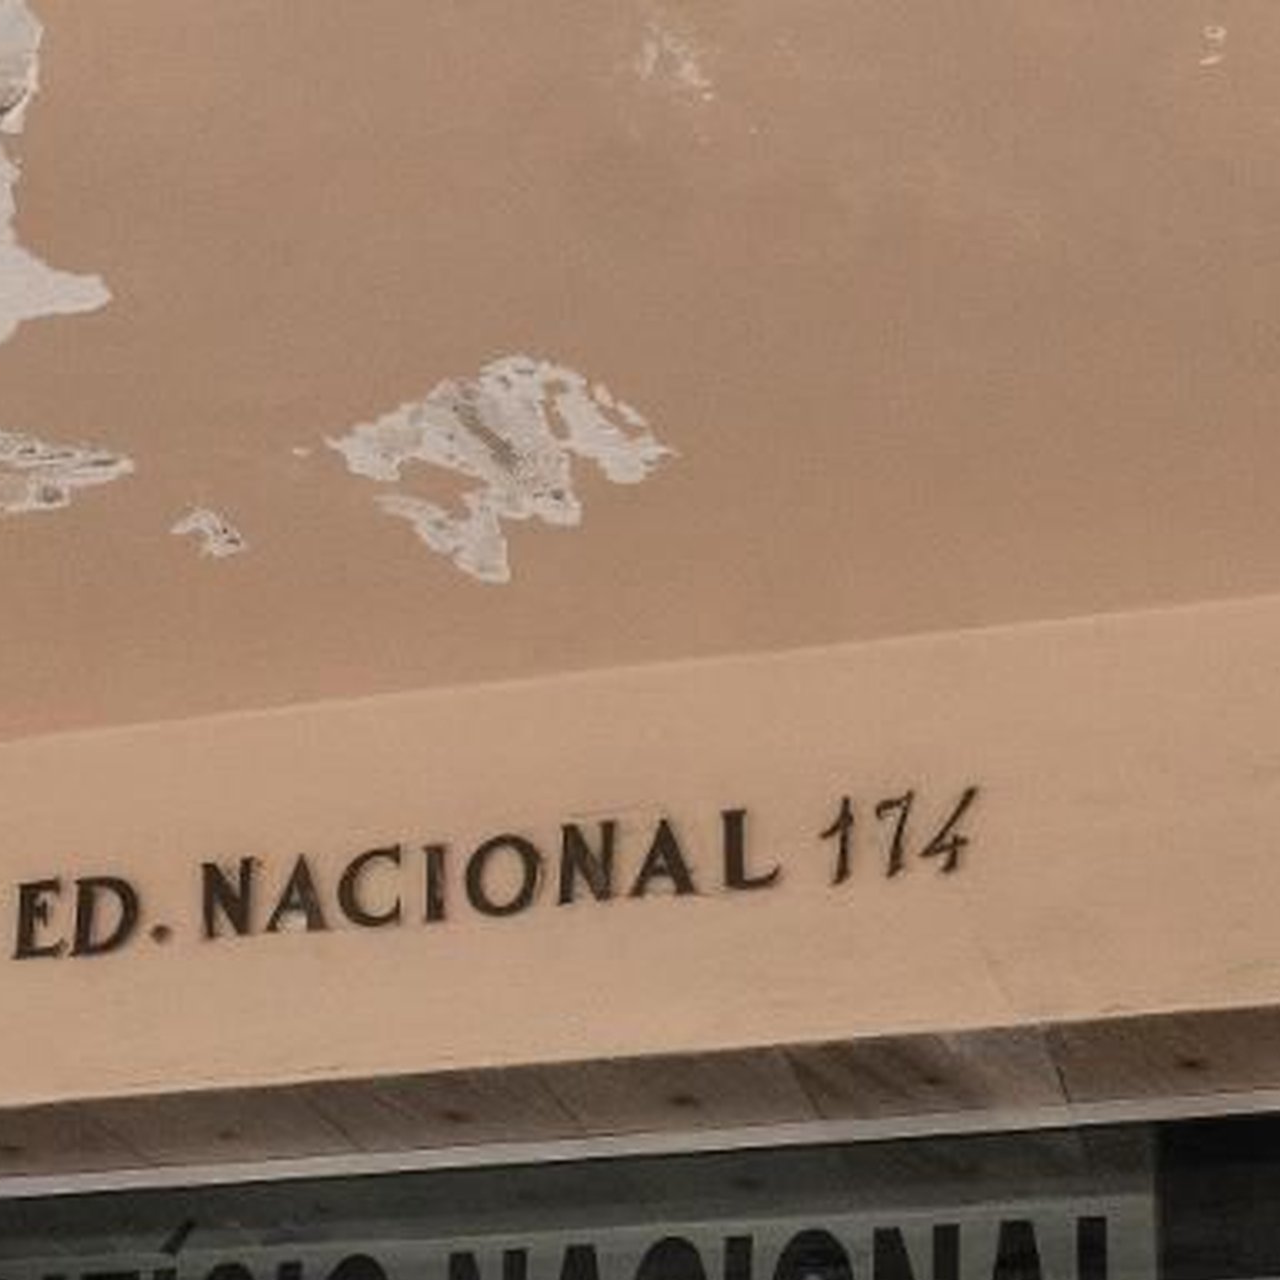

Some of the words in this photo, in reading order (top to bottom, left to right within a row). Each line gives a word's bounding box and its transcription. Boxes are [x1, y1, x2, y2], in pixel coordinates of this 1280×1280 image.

[11, 874, 172, 961] ED.
[199, 808, 784, 942] NACIONAL
[817, 786, 980, 887] 174
